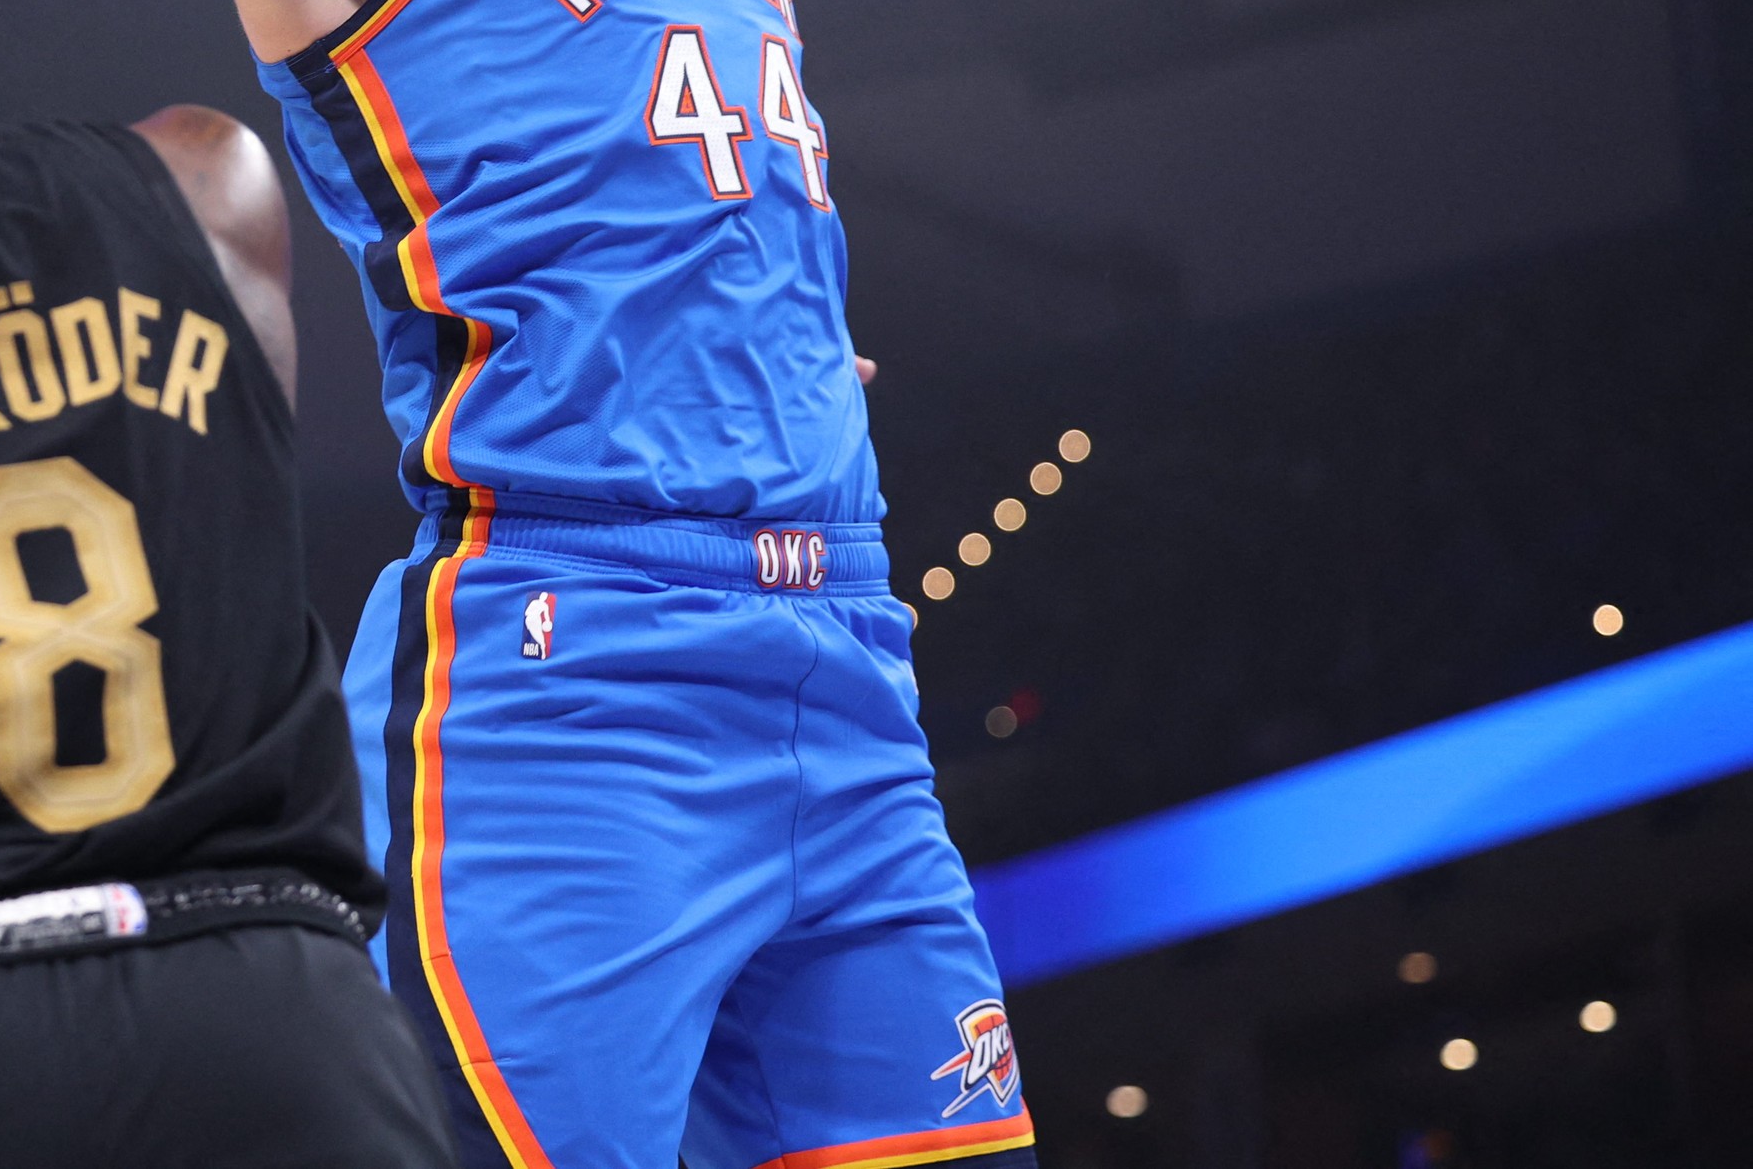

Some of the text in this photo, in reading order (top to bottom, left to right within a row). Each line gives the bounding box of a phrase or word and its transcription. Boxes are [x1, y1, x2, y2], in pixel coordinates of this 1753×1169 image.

[644, 25, 831, 213] 44
[754, 528, 827, 592] OKC
[523, 642, 539, 657] NBA
